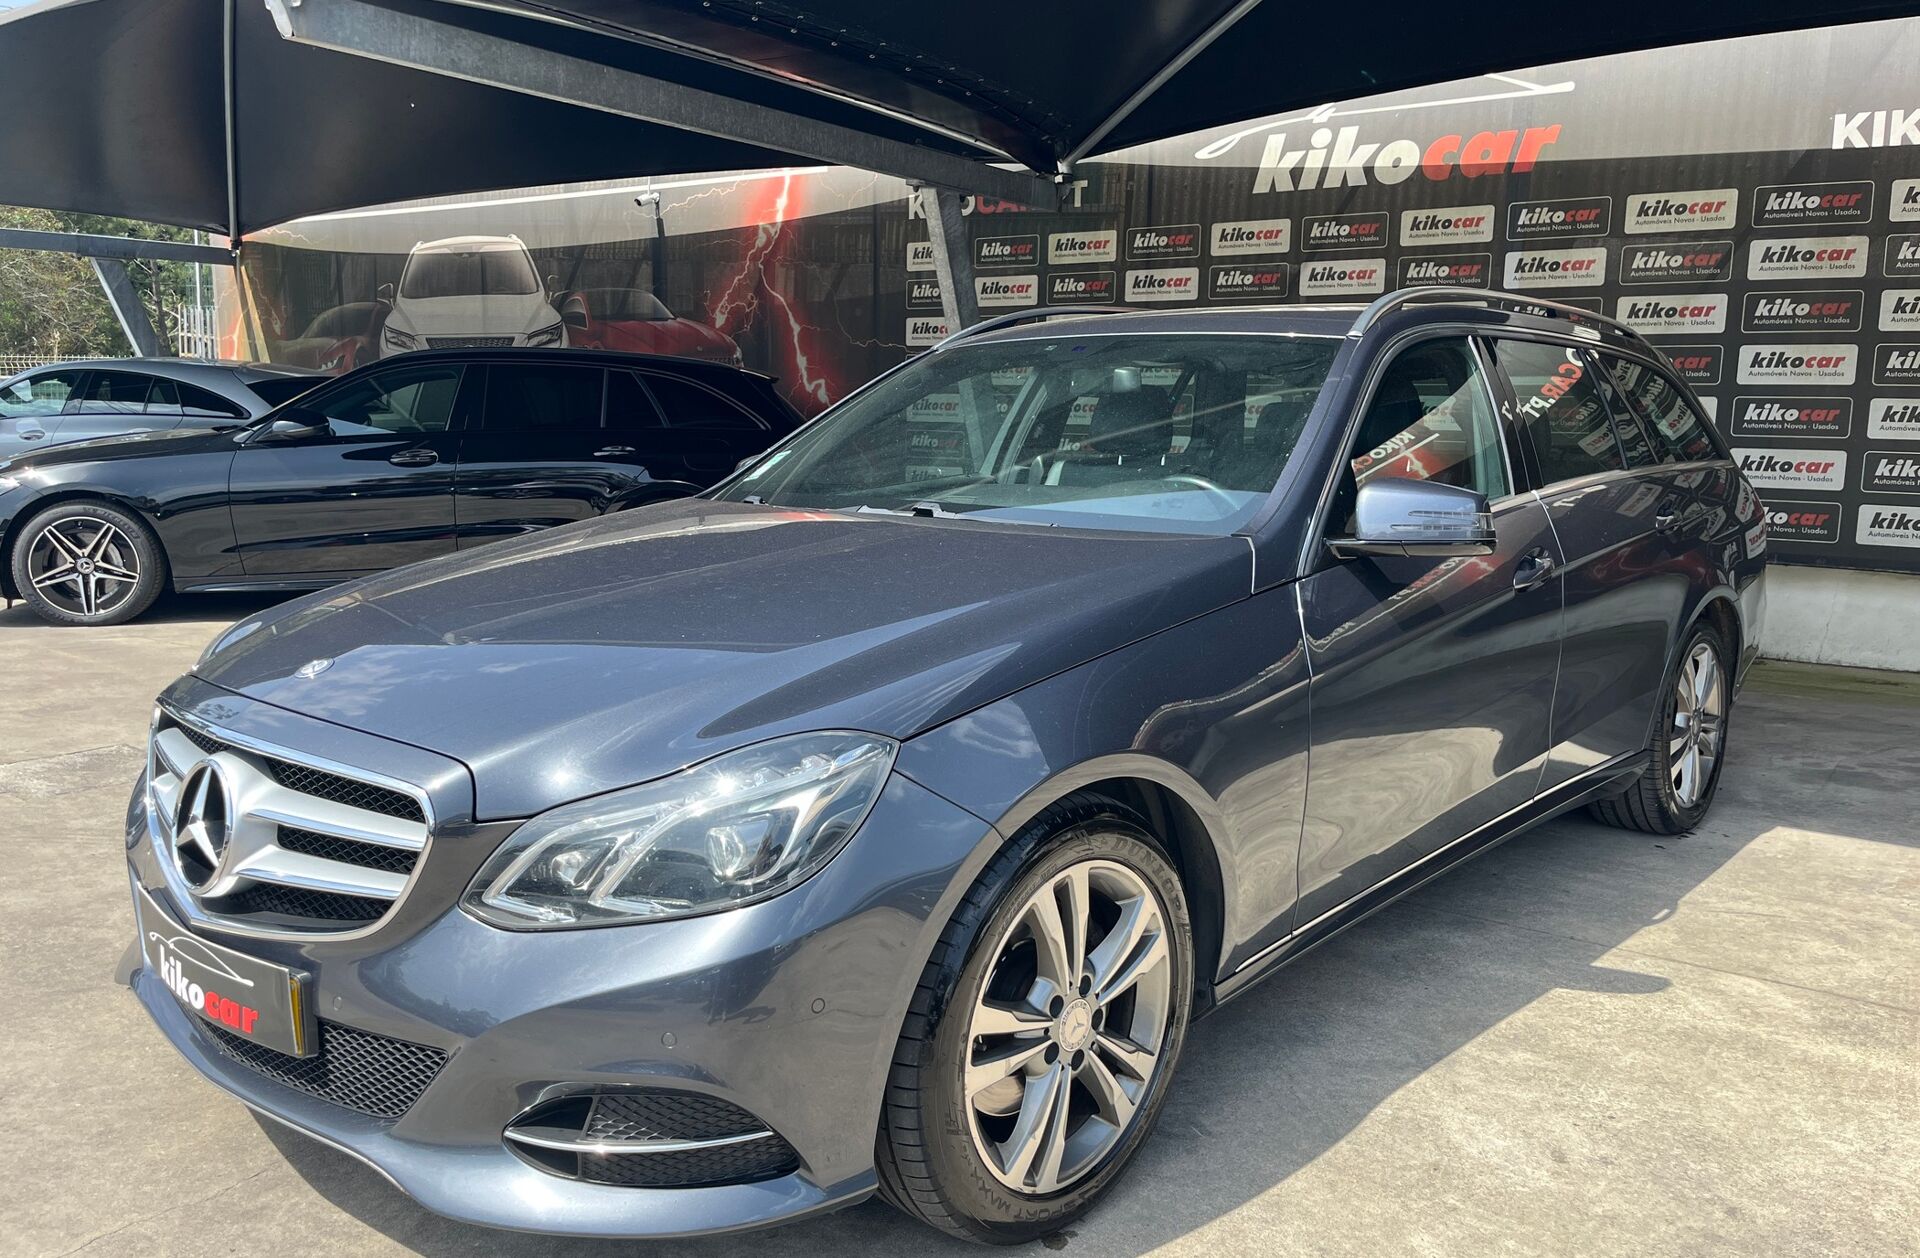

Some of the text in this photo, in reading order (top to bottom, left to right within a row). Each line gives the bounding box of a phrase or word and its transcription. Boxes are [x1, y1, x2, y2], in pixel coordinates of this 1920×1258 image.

[1252, 124, 1562, 194] kikocar
[1637, 200, 1726, 217] kikocar
[1765, 192, 1862, 210] kikocar
[1518, 207, 1600, 225] kikocar
[1763, 211, 1803, 219] Automóveis
[1834, 208, 1860, 216] Usados
[1310, 221, 1381, 237] kikocar
[1410, 215, 1485, 231] kikocar
[1517, 225, 1551, 233] Automóveis
[1577, 222, 1600, 230] Usados
[1635, 218, 1672, 226] Automóveis
[1134, 233, 1194, 247] kikocar
[1219, 228, 1283, 242] kikocar
[981, 243, 1032, 256] kikocar
[1055, 238, 1110, 251] kikocar
[1632, 251, 1722, 268] kikocar
[1760, 246, 1856, 263] kikocar
[1407, 262, 1481, 278] kikocar
[1514, 257, 1596, 273] kikocar
[1758, 264, 1798, 272] Automóveis
[1133, 275, 1192, 288] kikocar
[1217, 271, 1280, 285] kikocar
[1308, 267, 1377, 281] kikocar
[981, 282, 1032, 294] kikocar
[1053, 279, 1109, 292] kikocar
[1627, 303, 1716, 318] kikocar
[1754, 299, 1851, 316] kikocar
[1892, 296, 1920, 314] ki
[1750, 352, 1846, 368] kikocar
[1744, 404, 1840, 421] kikocar
[1742, 455, 1834, 473] kikocar
[1875, 458, 1920, 477] kik
[1873, 478, 1915, 486] Automóveis
[1868, 531, 1909, 539] Automóveis
[160, 944, 259, 1033] kikocar
